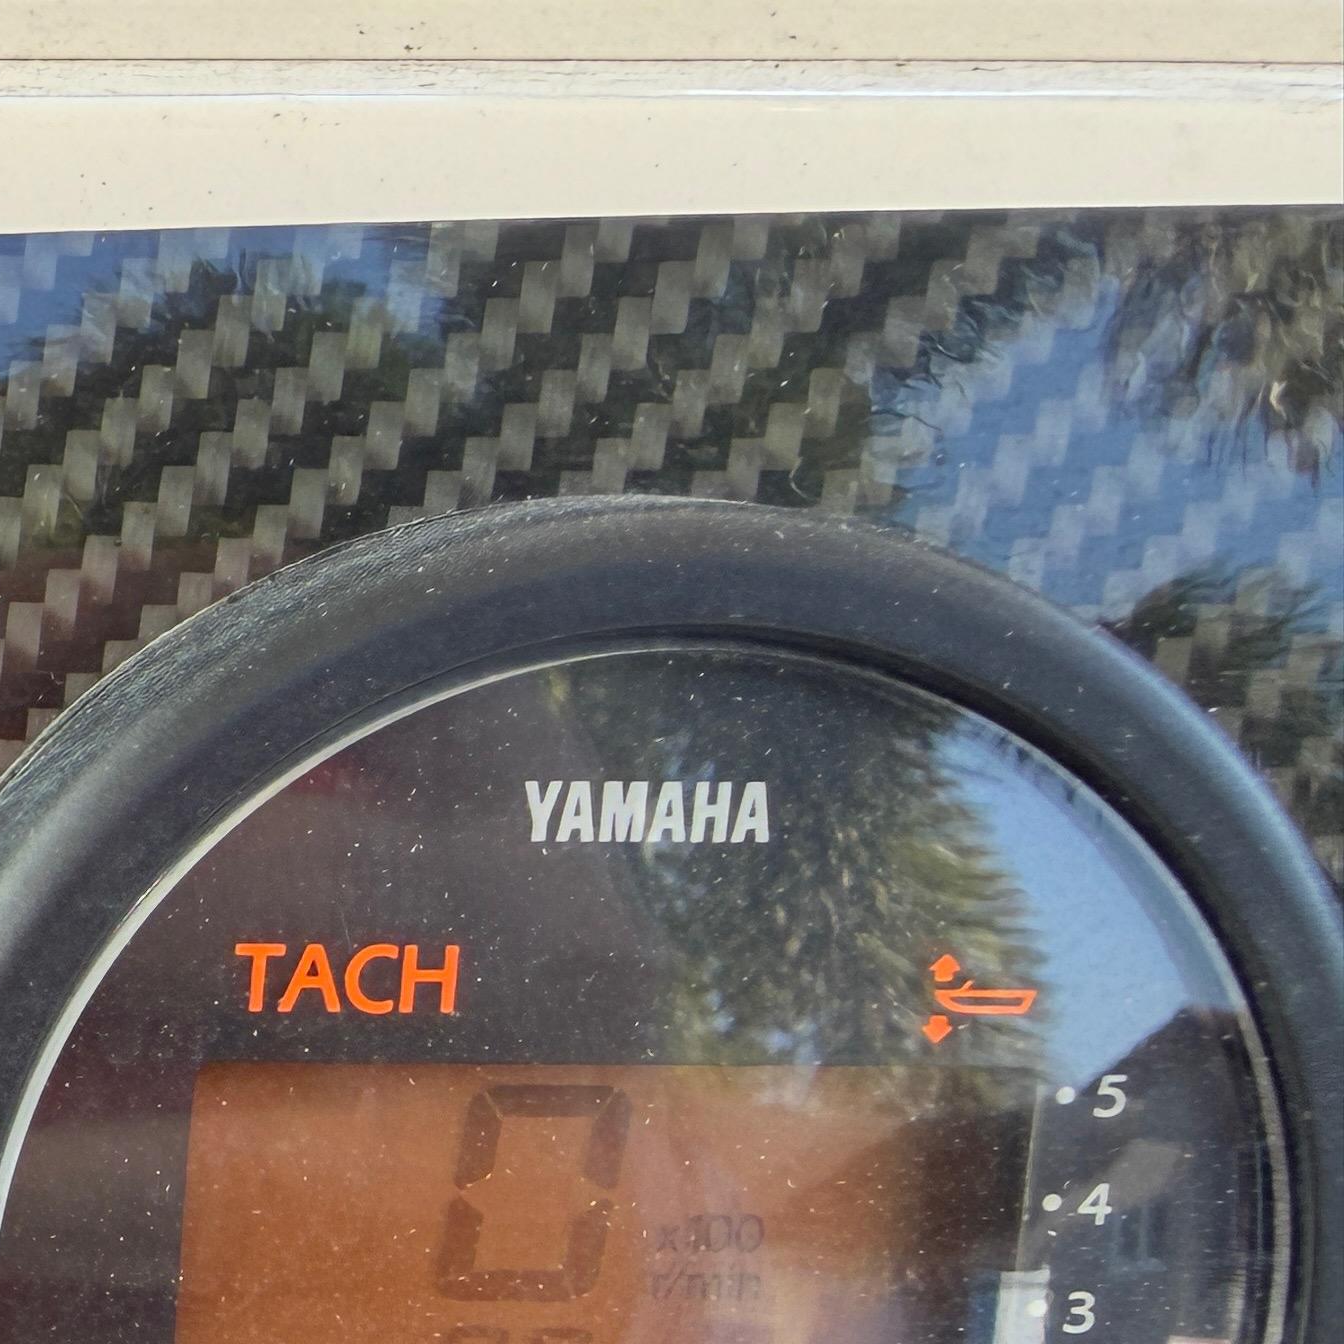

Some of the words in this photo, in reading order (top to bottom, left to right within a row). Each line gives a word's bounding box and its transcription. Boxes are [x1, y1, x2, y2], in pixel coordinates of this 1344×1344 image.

[524, 780, 769, 843] YAMAHA
[235, 943, 460, 1014] TACH
[1092, 1076, 1128, 1120] 5
[435, 1084, 631, 1303] 0
[1077, 1183, 1112, 1227] 4
[1064, 1292, 1096, 1335] 3
